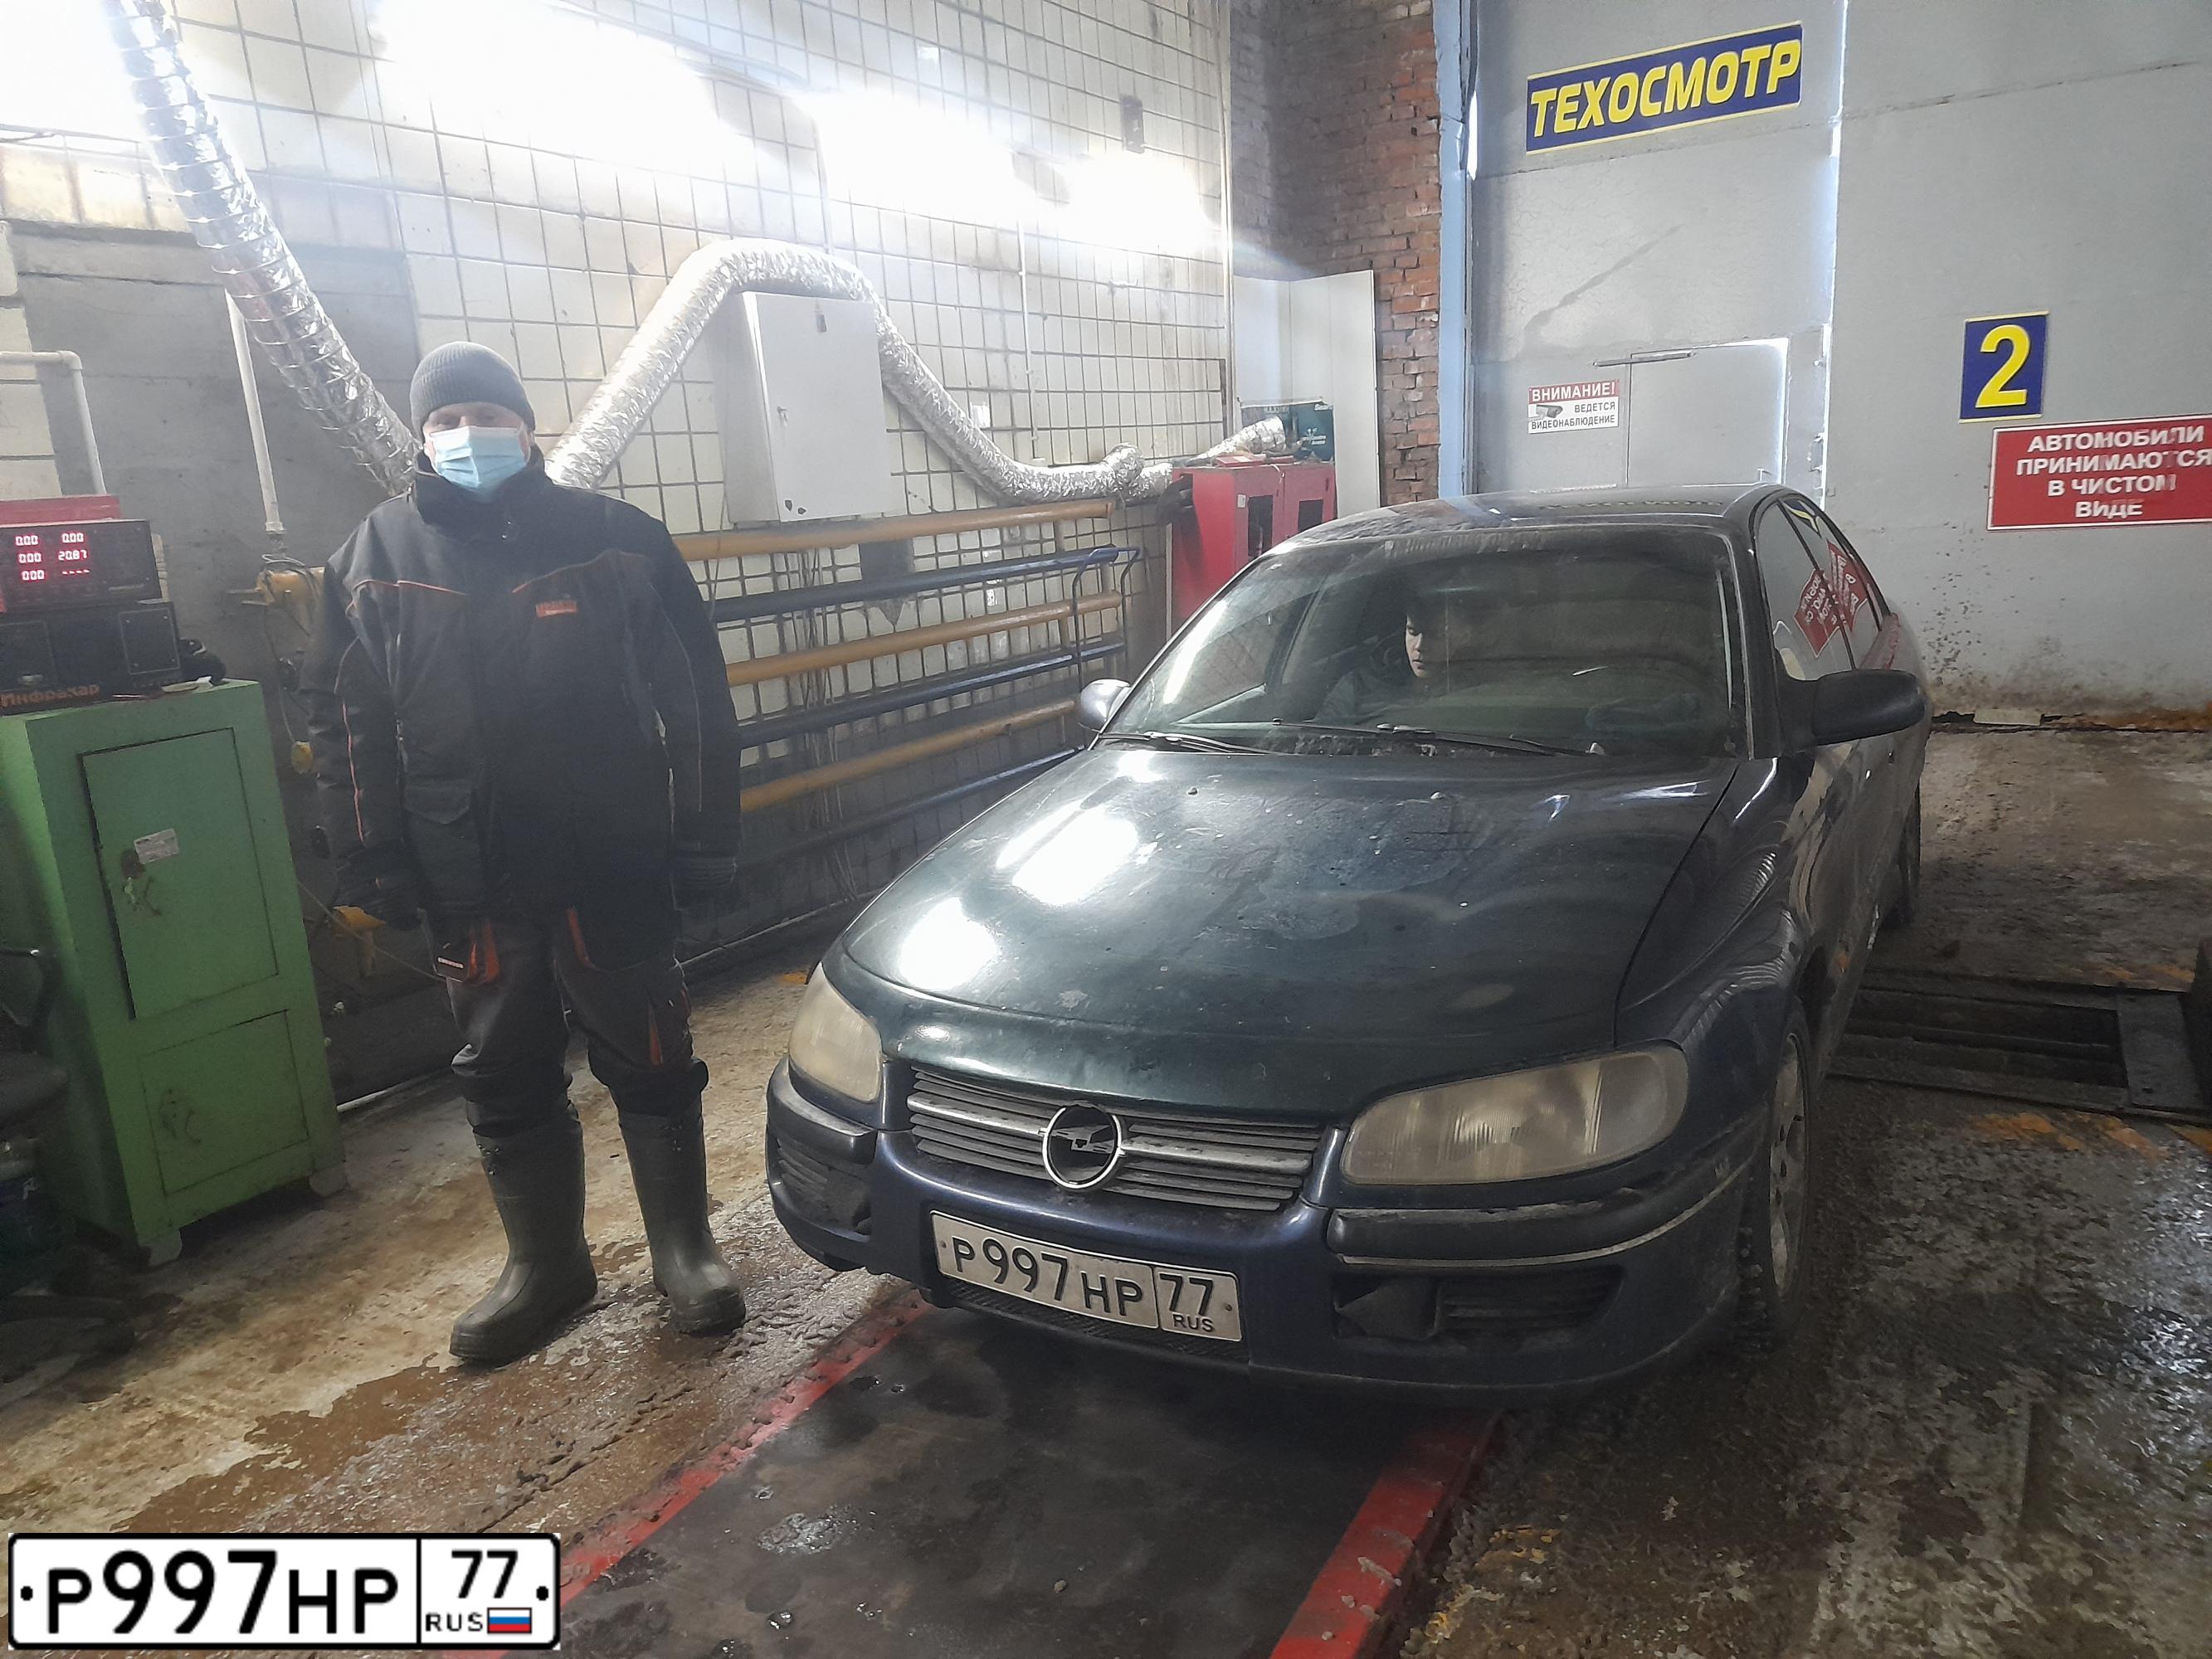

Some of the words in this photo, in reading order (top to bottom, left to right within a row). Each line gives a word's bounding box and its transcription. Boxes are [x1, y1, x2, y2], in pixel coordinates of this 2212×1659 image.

[1530, 38, 1801, 138] ТЕХОСМОТР
[1975, 324, 2031, 409] 2
[1532, 382, 1615, 401] ВНИМАНИЕ!
[1574, 401, 1615, 413] ВЕДЕТСЯ
[1532, 415, 1615, 430] ВИДЕОНАБЛЮДЕНИЕ
[2027, 426, 2205, 453] АВТОМОБИЛИ
[2048, 479, 2065, 497] В
[2071, 474, 2177, 495] ЧИСТОМ
[1159, 1273, 1214, 1316] 77
[1172, 1313, 1214, 1332] RUS
